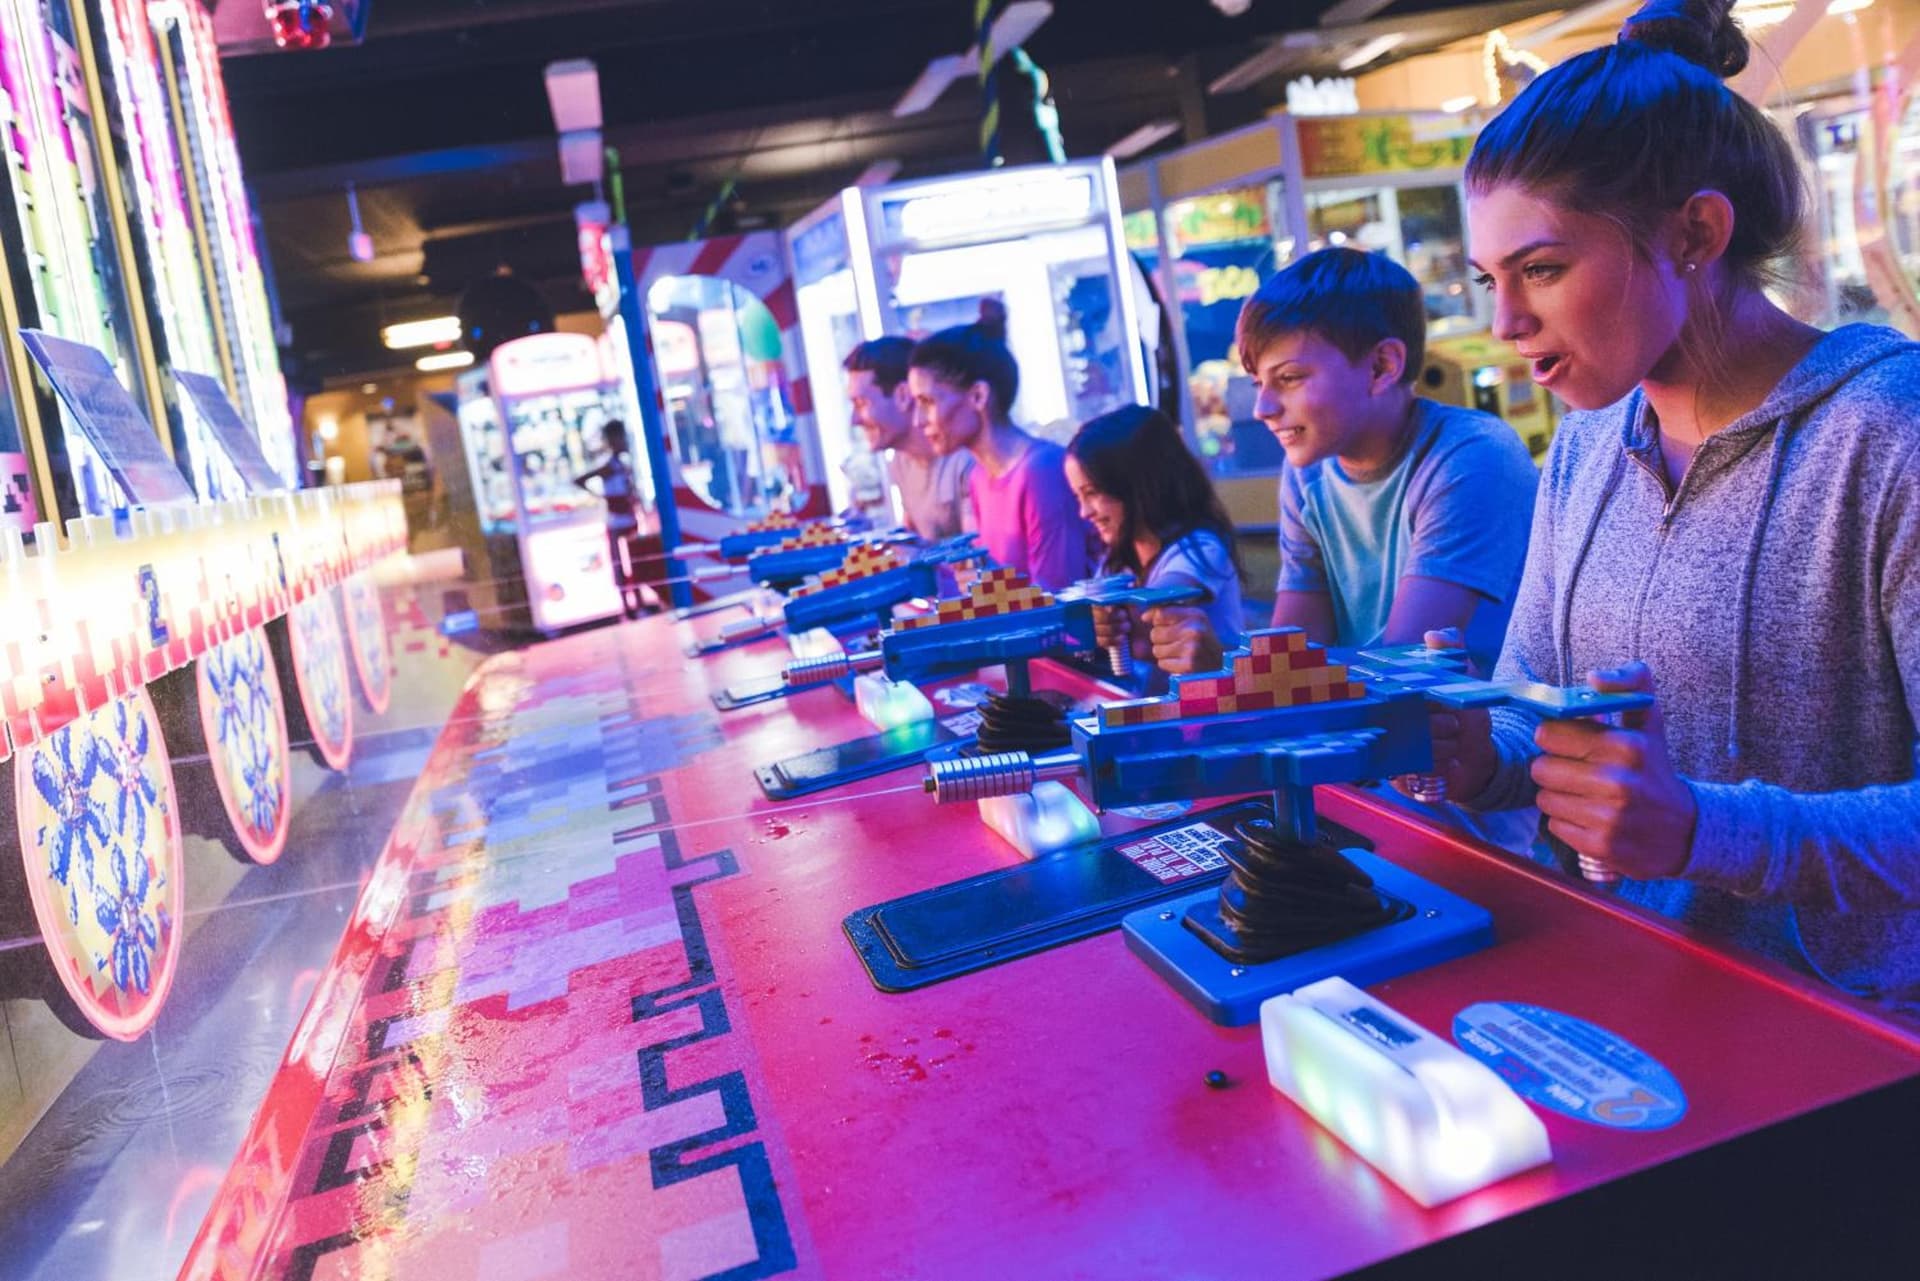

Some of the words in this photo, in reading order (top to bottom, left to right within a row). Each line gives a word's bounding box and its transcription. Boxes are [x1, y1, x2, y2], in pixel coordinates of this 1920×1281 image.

[138, 563, 169, 648] 2
[1461, 1029, 1504, 1057] HERE
[1546, 1083, 1586, 1110] WIN
